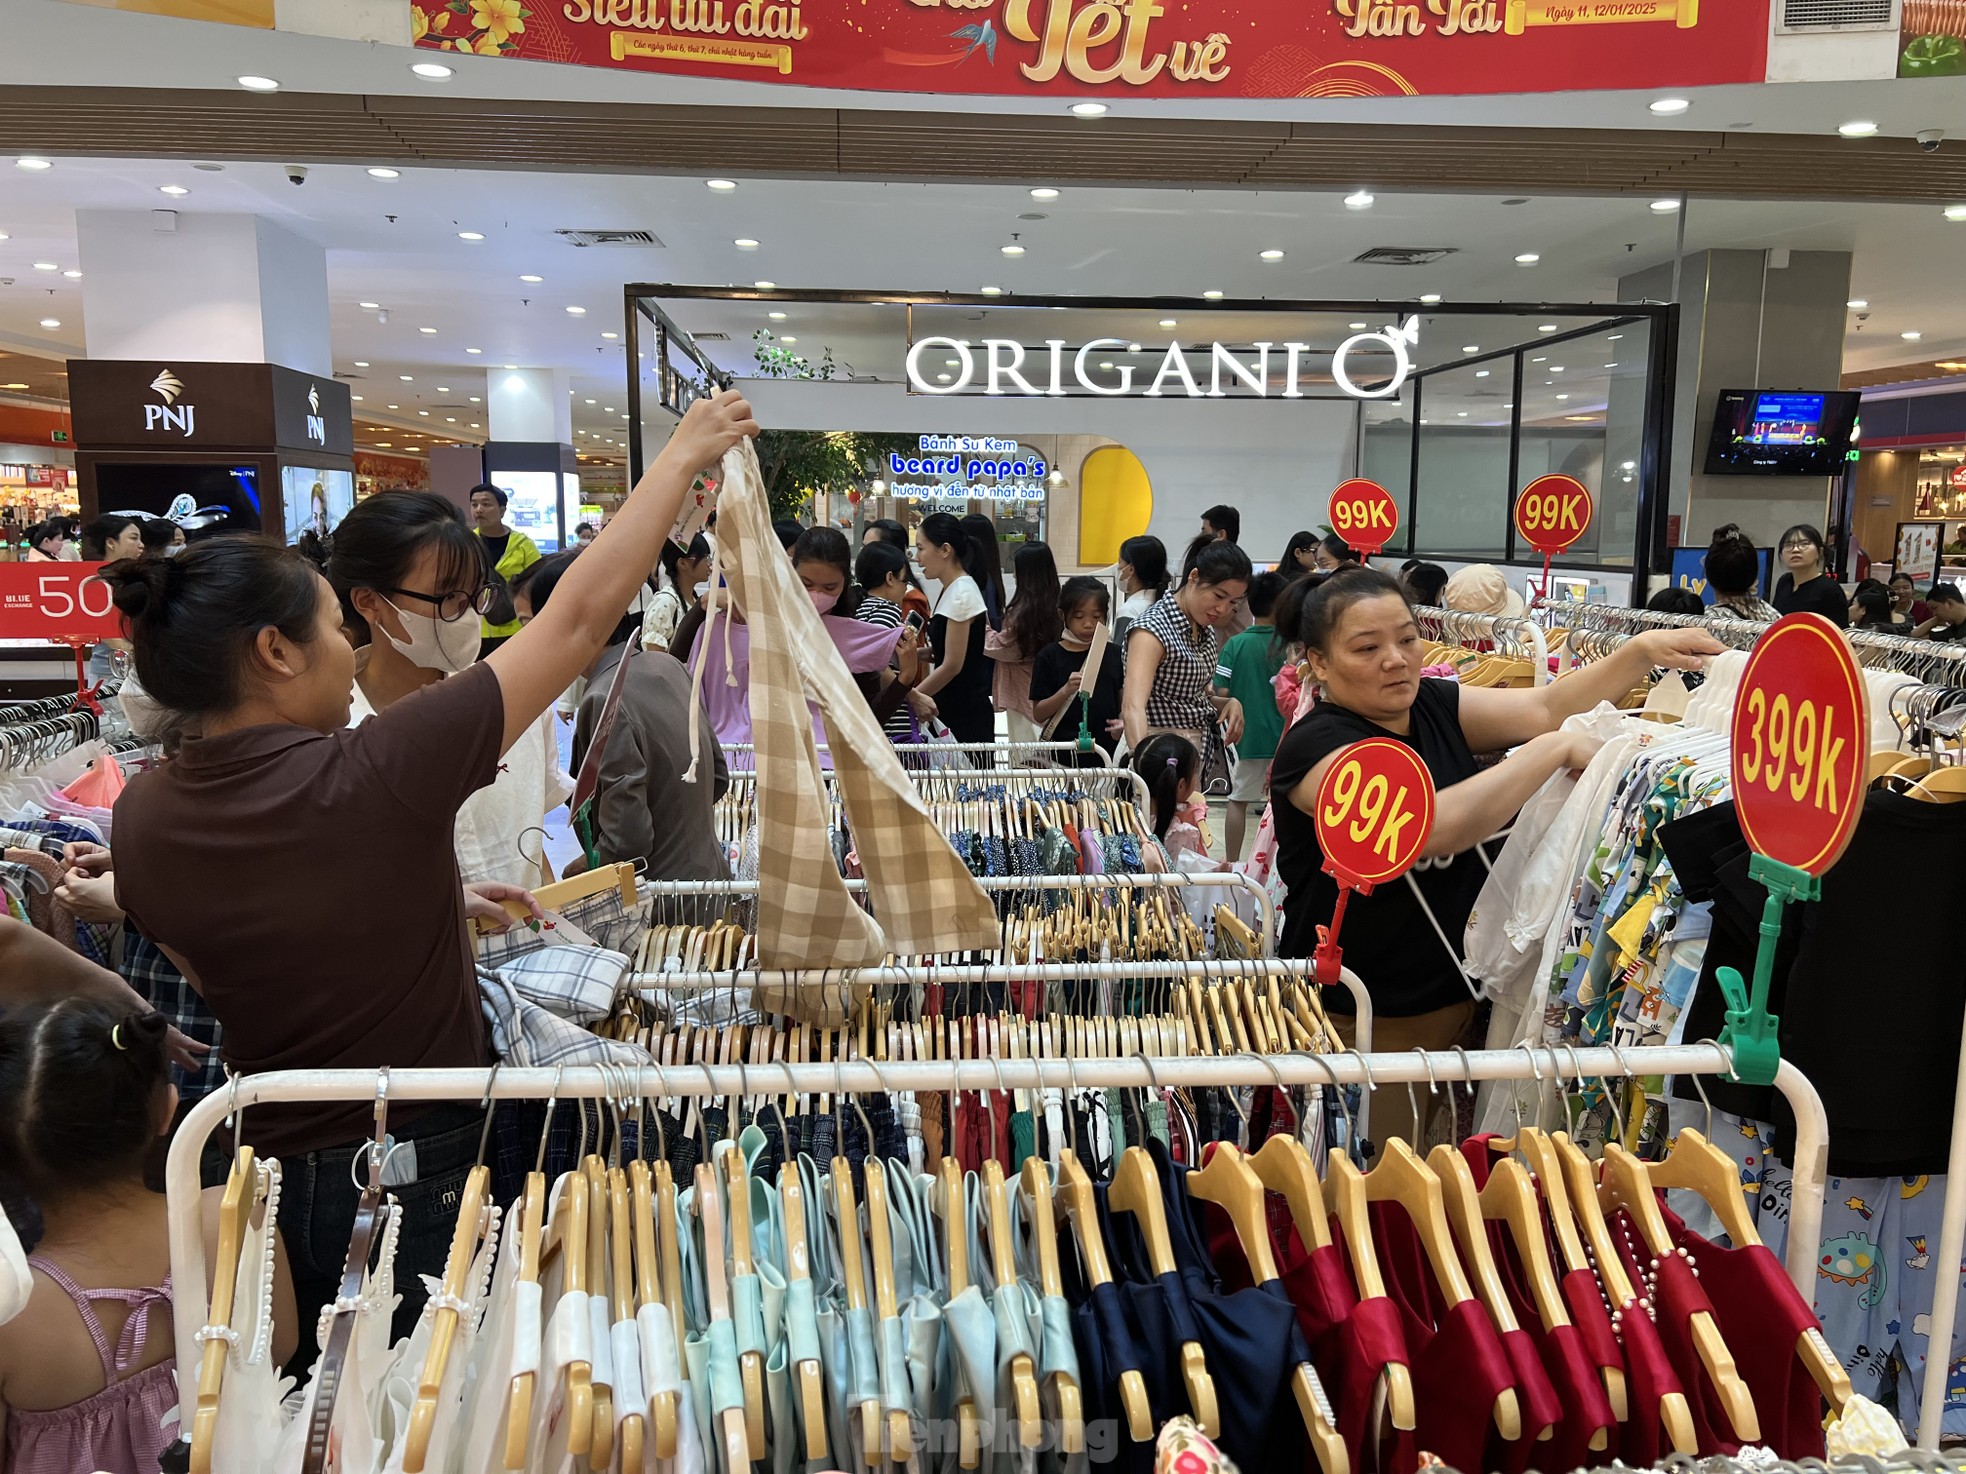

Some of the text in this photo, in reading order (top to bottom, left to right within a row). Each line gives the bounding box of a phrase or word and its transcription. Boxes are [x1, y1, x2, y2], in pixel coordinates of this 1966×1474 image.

[1545, 6, 1575, 22] Ngày
[1594, 2, 1657, 17] 12/01/2025
[905, 336, 1304, 397] ORIGANI
[144, 404, 195, 437] PNJ
[306, 414, 325, 446] PNJ
[920, 436, 1016, 452] Bánh Su Kem
[891, 454, 1045, 480] beard papa's
[892, 485, 929, 499] hương
[947, 482, 969, 496] đến
[918, 504, 965, 513] WELCOME
[1335, 499, 1392, 529] 99K
[1525, 494, 1582, 531] 99K
[5, 594, 31, 602] BLUE
